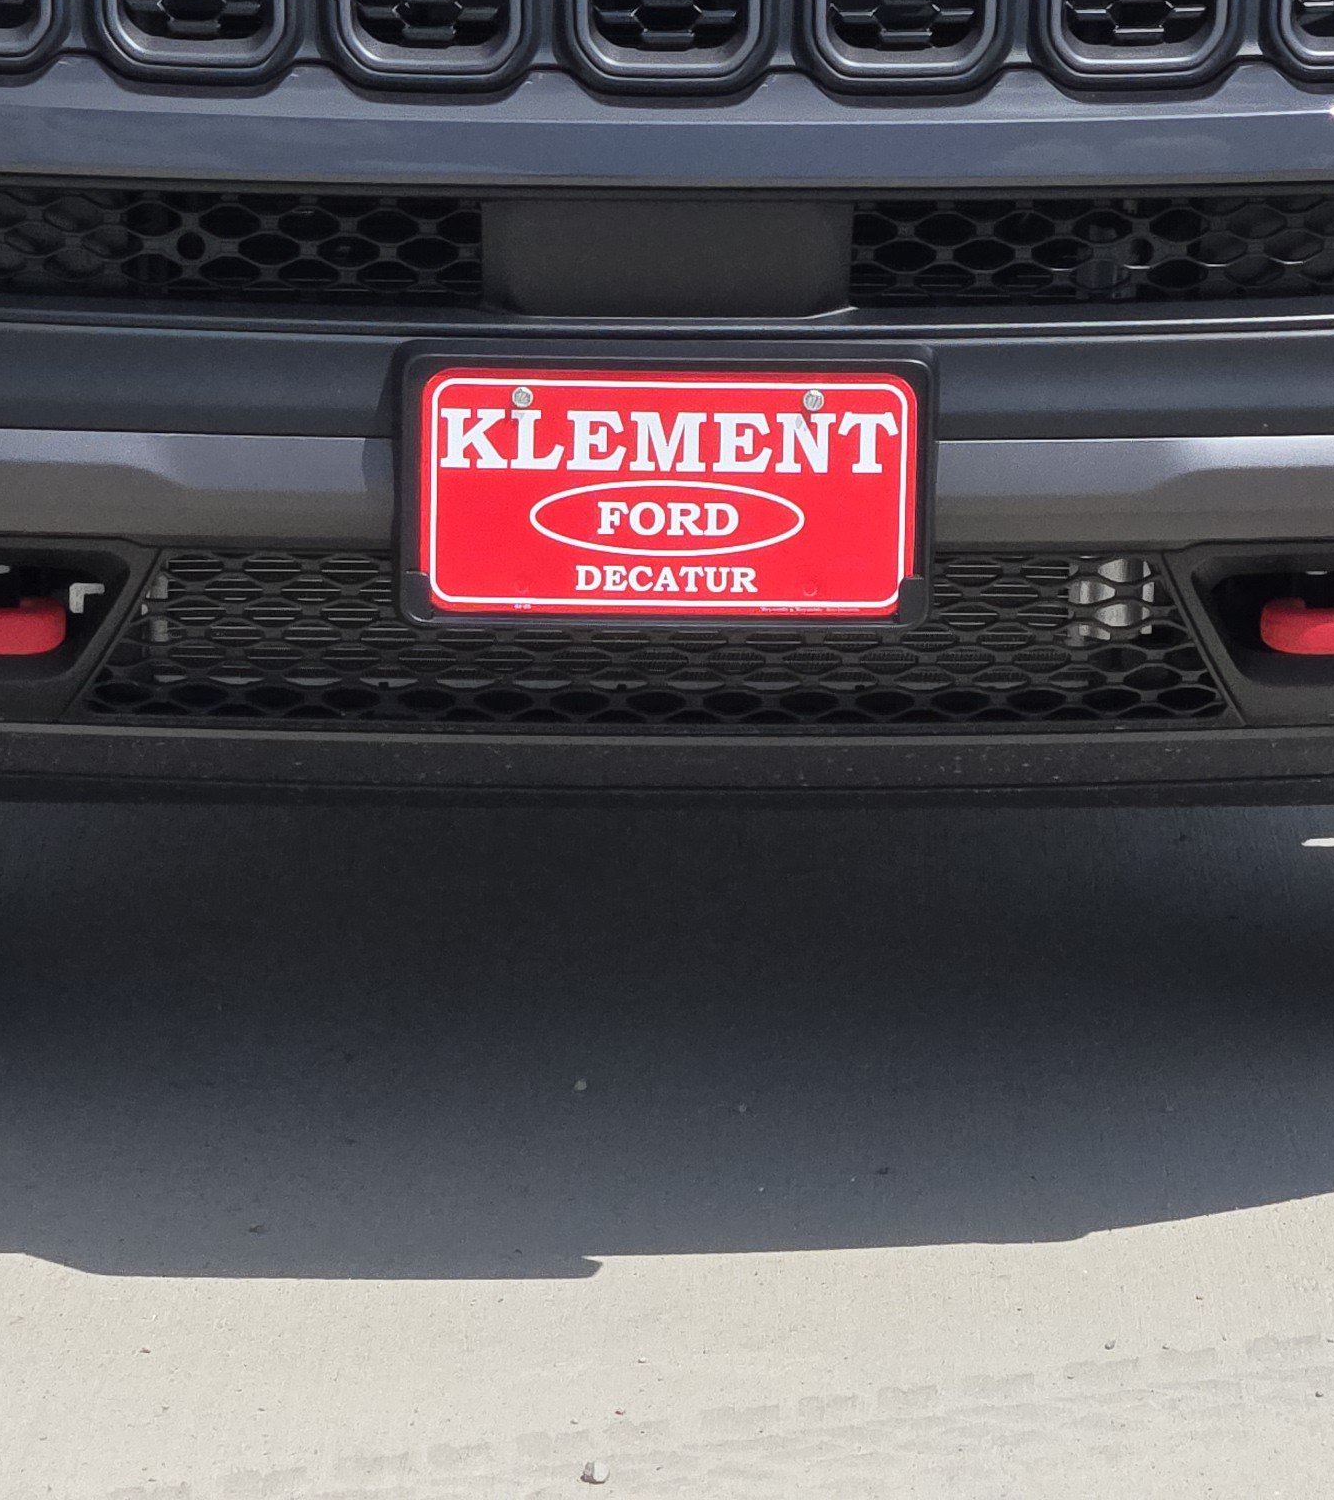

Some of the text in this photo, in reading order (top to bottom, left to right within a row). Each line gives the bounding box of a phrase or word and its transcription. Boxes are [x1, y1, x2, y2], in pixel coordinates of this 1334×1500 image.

[439, 407, 900, 474] KLEMENT
[596, 501, 740, 537] FORD
[574, 564, 759, 594] DECATUR
